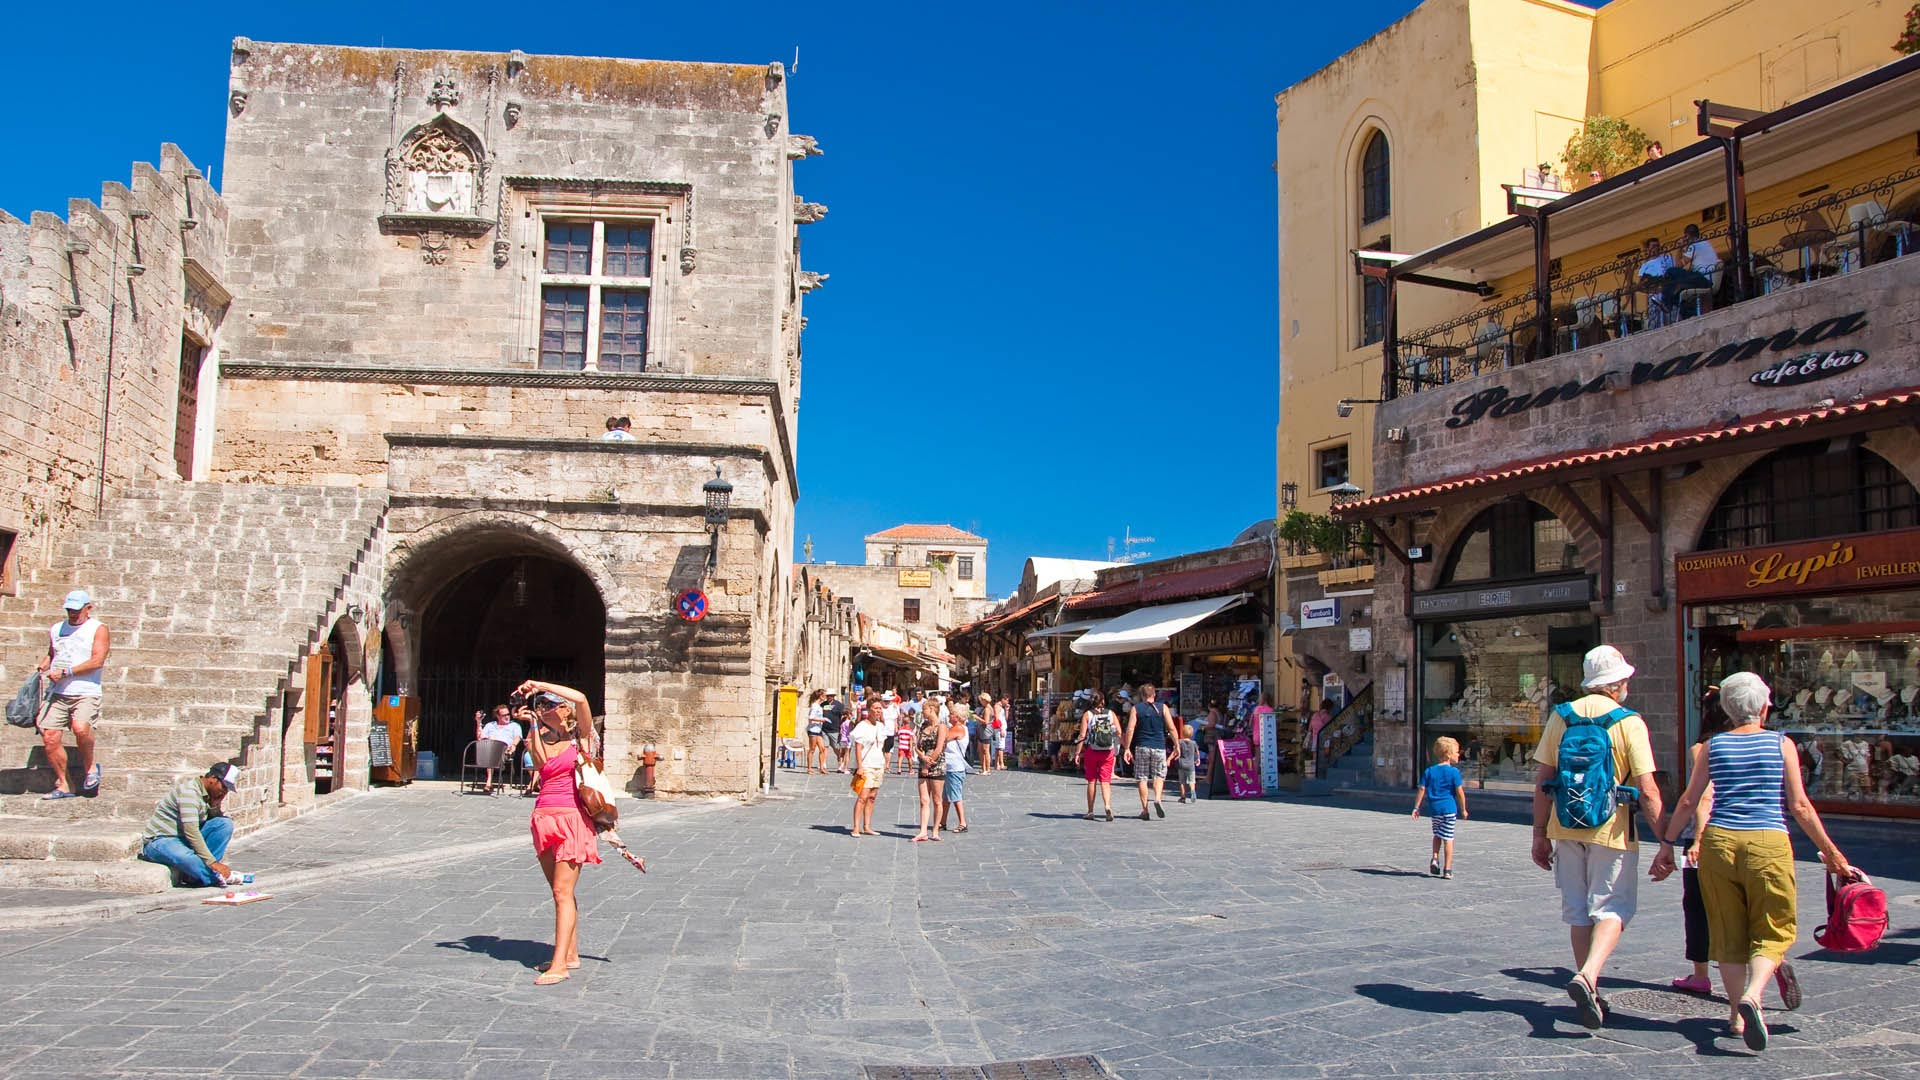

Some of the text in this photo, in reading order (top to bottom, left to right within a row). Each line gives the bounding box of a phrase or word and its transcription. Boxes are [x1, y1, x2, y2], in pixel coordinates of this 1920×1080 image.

[1445, 311, 1869, 429] Panrama
[1751, 350, 1865, 384] cafe & bar
[1677, 554, 1747, 572] ΚΟΣΜΗΜΑΤΑ
[1745, 542, 1855, 588] Lapis
[1857, 560, 1920, 580] JEWELLERY
